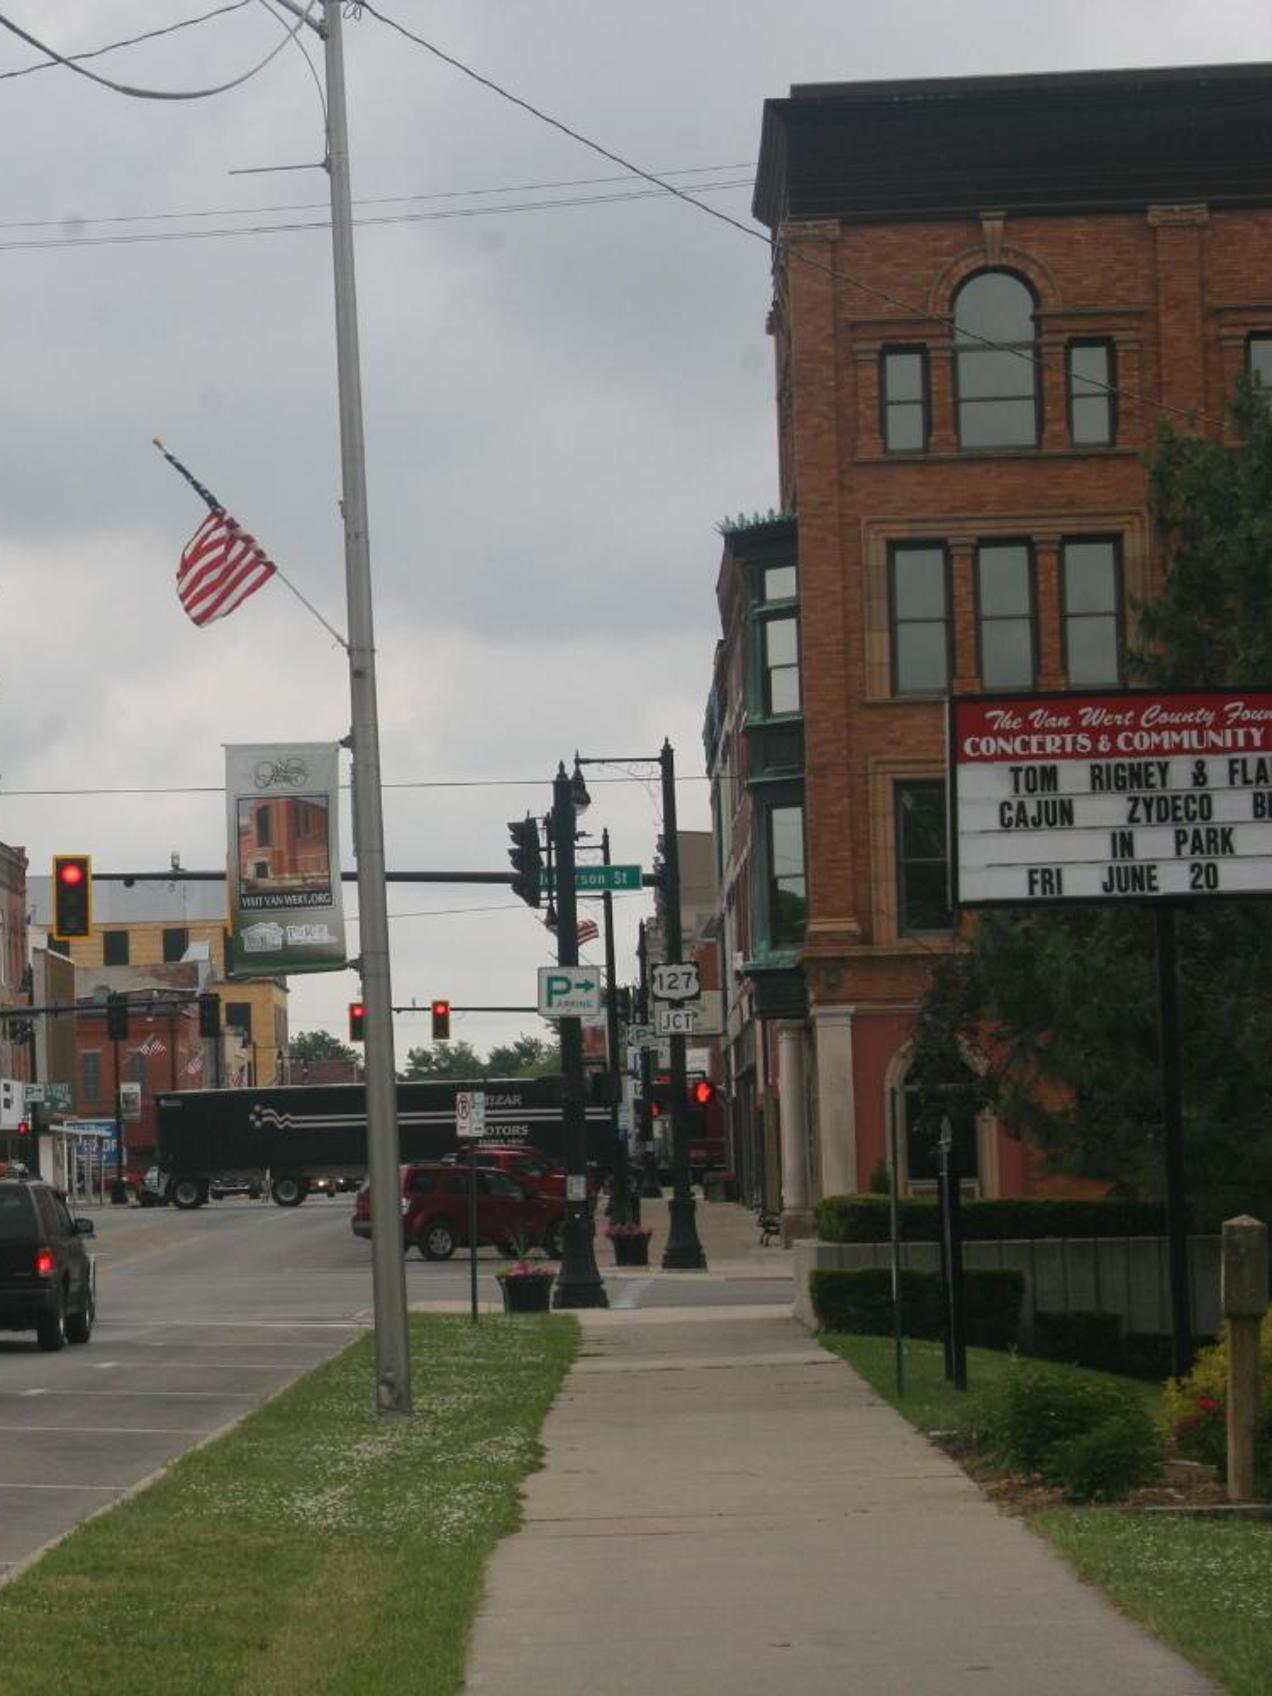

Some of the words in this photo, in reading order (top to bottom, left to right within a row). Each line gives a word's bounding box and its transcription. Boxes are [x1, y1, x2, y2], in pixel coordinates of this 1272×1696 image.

[985, 709, 1023, 731] The
[1029, 708, 1071, 729] Van
[1078, 706, 1134, 728] Wert
[1141, 704, 1216, 728] County
[963, 733, 1092, 758] CONCERTS
[1097, 734, 1113, 752] &
[1117, 727, 1265, 751] COMMUNITY
[1009, 764, 1059, 794] TOM
[1090, 760, 1171, 792] RIGNEY
[1228, 757, 1272, 787] FLA
[999, 798, 1075, 829] CAJUN
[1126, 793, 1213, 824] ZYDECO
[1110, 830, 1135, 860] IN
[1174, 827, 1235, 856] PARK
[1028, 867, 1063, 897] FRI
[1102, 864, 1160, 894] JUNE
[1189, 862, 1219, 891] 20
[658, 971, 693, 991] 127
[663, 1014, 692, 1030] JCT
[485, 1125, 529, 1137] OTORS
